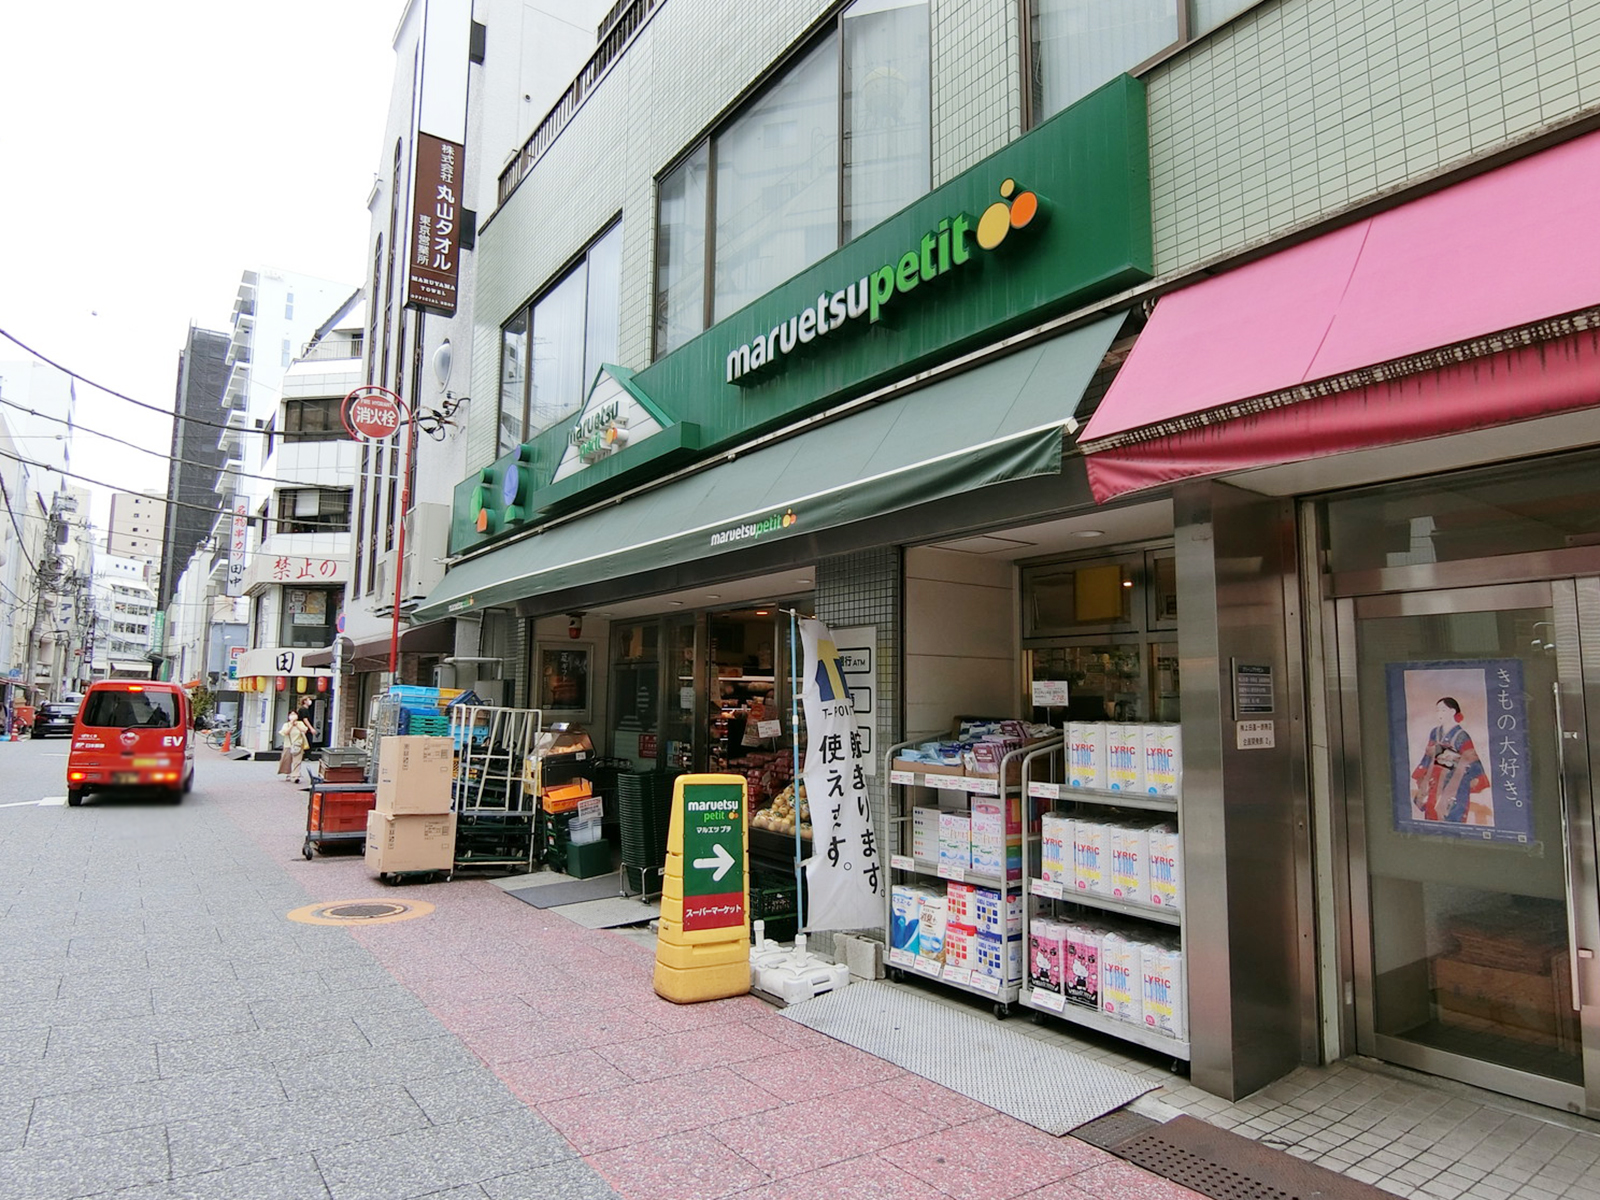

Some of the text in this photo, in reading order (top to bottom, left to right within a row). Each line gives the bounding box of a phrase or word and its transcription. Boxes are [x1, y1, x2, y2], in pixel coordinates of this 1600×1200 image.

[433, 143, 455, 270] 株式会社 丸山タオル
[416, 213, 432, 266] 東京営業所
[411, 275, 456, 291] MARUYAMA
[420, 285, 446, 296] TOWEL
[410, 294, 439, 304] OFFICIAL
[356, 405, 397, 427] 消火栓
[273, 556, 338, 581] 禁止の
[229, 563, 243, 588] 田中
[852, 659, 866, 667] ATM
[163, 736, 184, 747] EV
[1497, 668, 1523, 808] きもの大好き。
[1071, 743, 1095, 752] LYRIC
[1110, 745, 1135, 755] LYRIC
[1146, 747, 1173, 757] LYRIC
[688, 799, 739, 811] maruetsu
[818, 733, 853, 871] 使えます。
[704, 810, 725, 823] petit
[696, 825, 720, 834] マルエツ
[1043, 837, 1063, 848] LYRIC
[1077, 844, 1100, 856] LYRIC
[1112, 849, 1138, 862] LYRIC
[1151, 855, 1175, 867] LYRIC
[686, 903, 742, 918] スーパーマーケット
[1104, 962, 1130, 977] LYRIC
[1143, 974, 1171, 989] LYRIC
